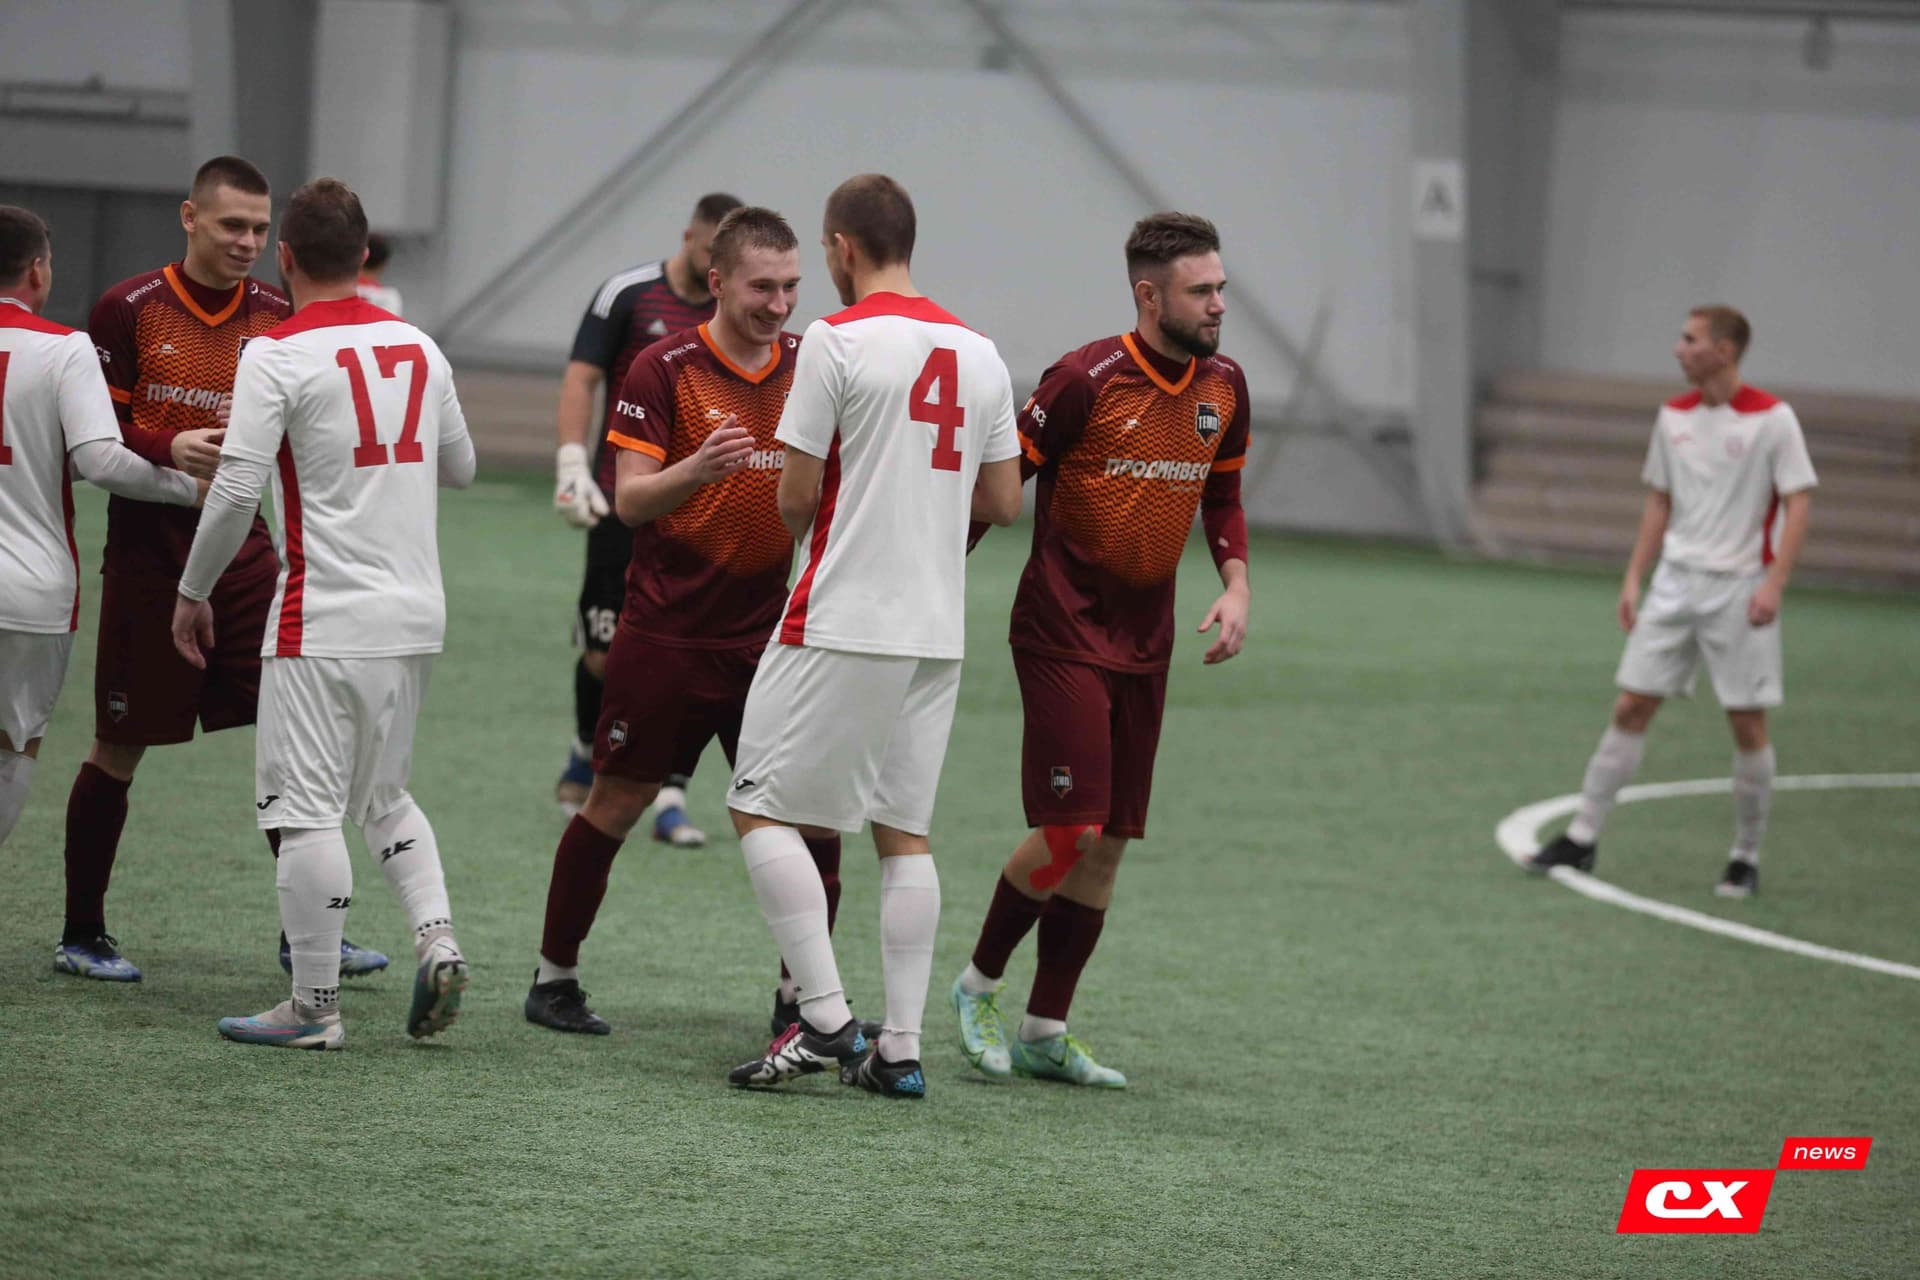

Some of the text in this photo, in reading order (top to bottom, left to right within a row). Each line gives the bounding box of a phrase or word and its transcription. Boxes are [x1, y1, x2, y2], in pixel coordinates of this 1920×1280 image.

[336, 343, 429, 468] 17
[909, 347, 965, 472] 4
[1104, 458, 1212, 481] ПРОДИНВЕС
